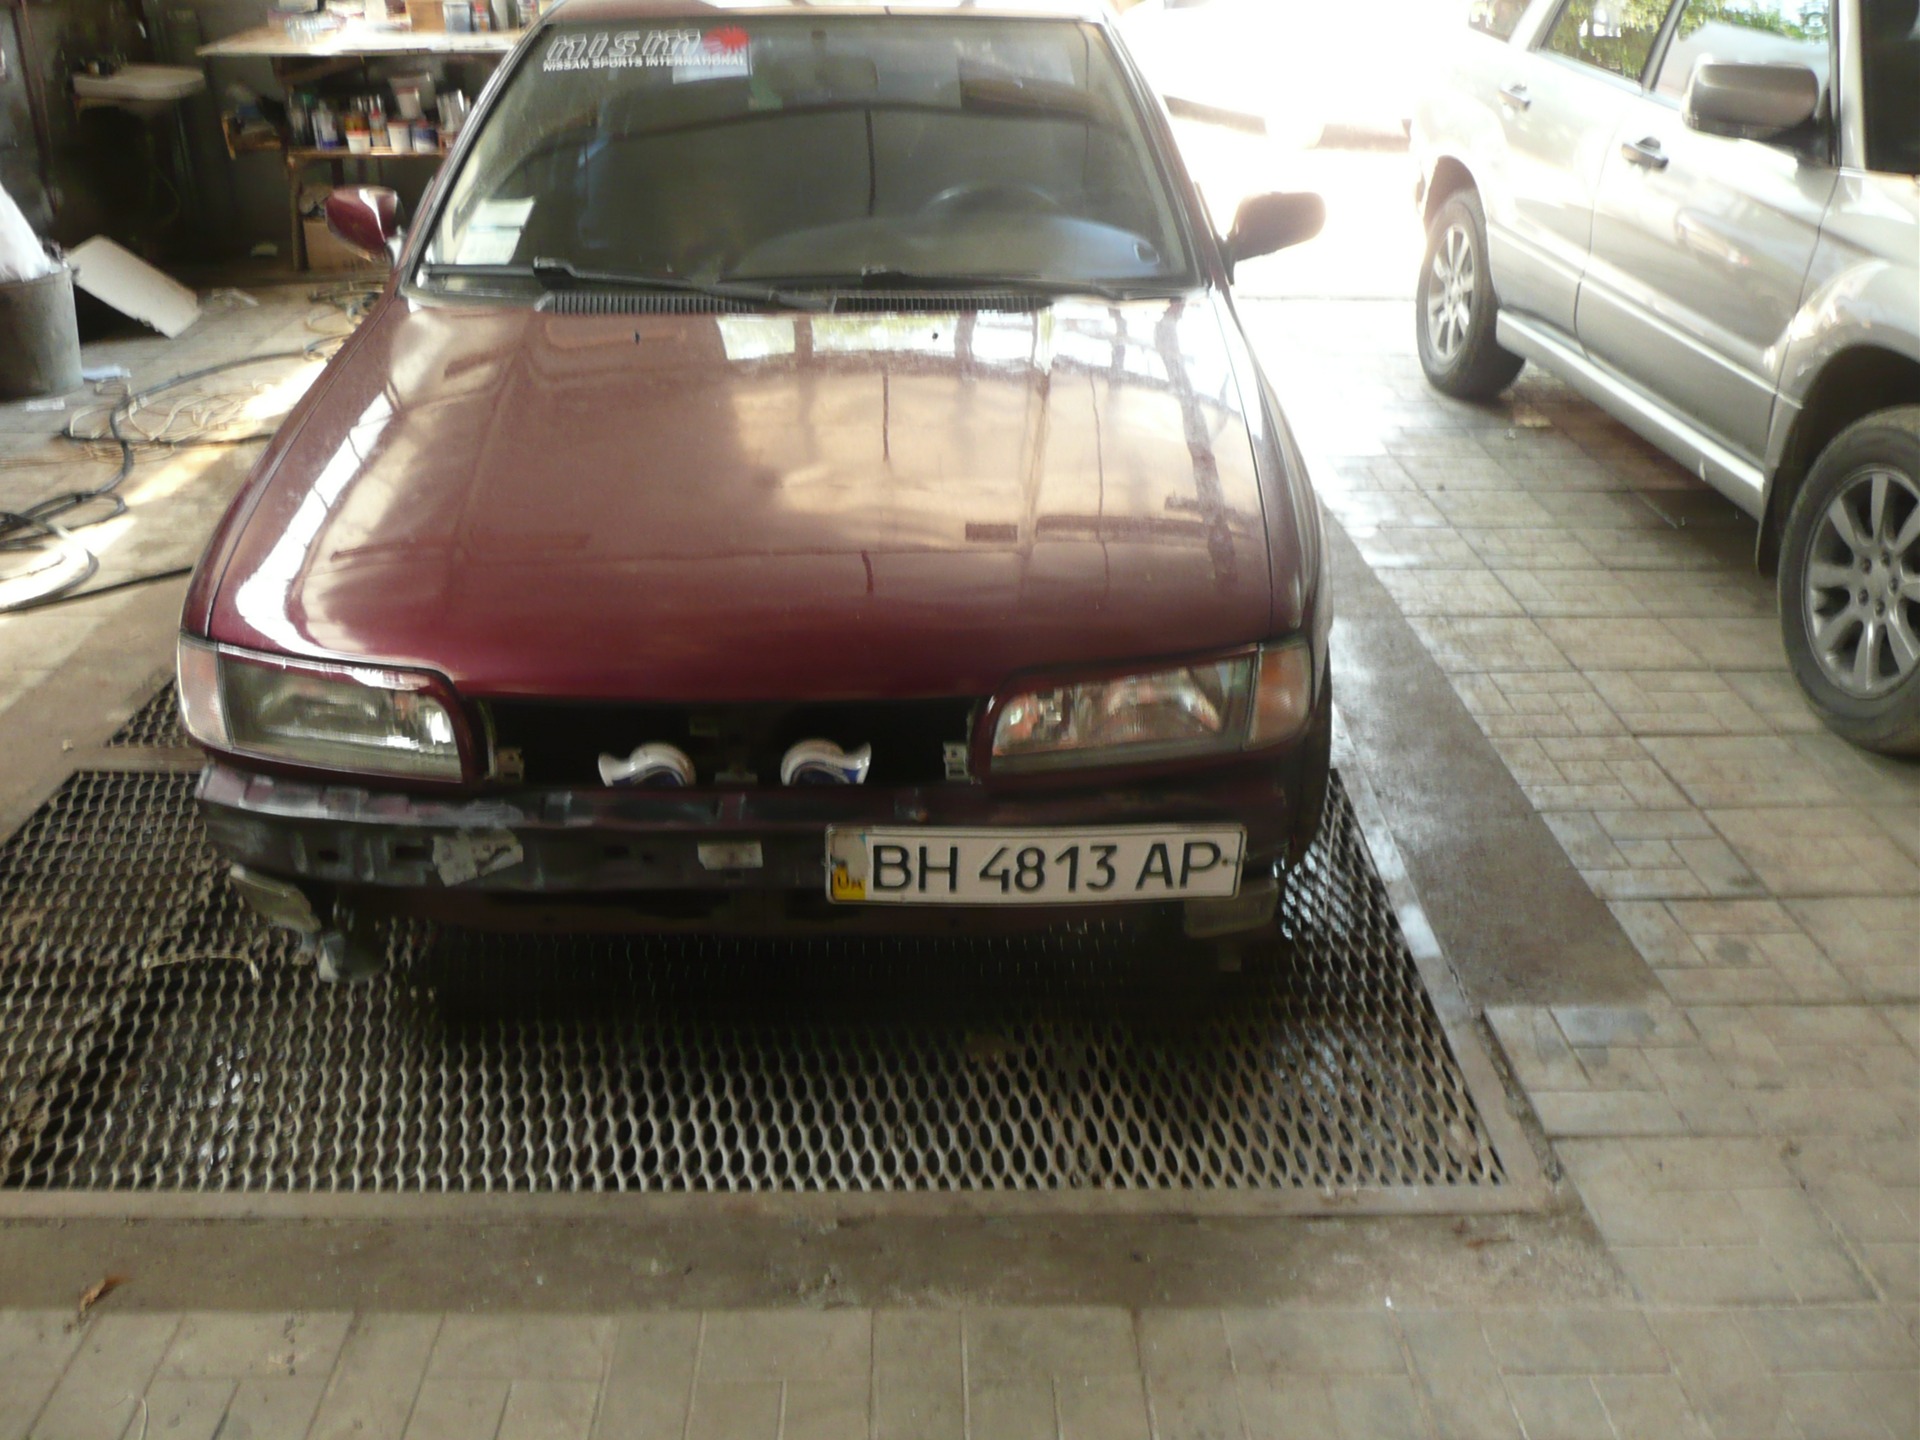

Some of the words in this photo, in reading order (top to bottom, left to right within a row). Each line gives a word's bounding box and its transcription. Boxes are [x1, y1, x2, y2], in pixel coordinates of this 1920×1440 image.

[543, 56, 589, 72] NISSAN
[592, 54, 643, 69] SPORTS
[645, 53, 747, 67] INTERNATIONAL
[872, 844, 959, 892] BH
[979, 844, 1117, 894] 4813
[1135, 841, 1222, 891] AP
